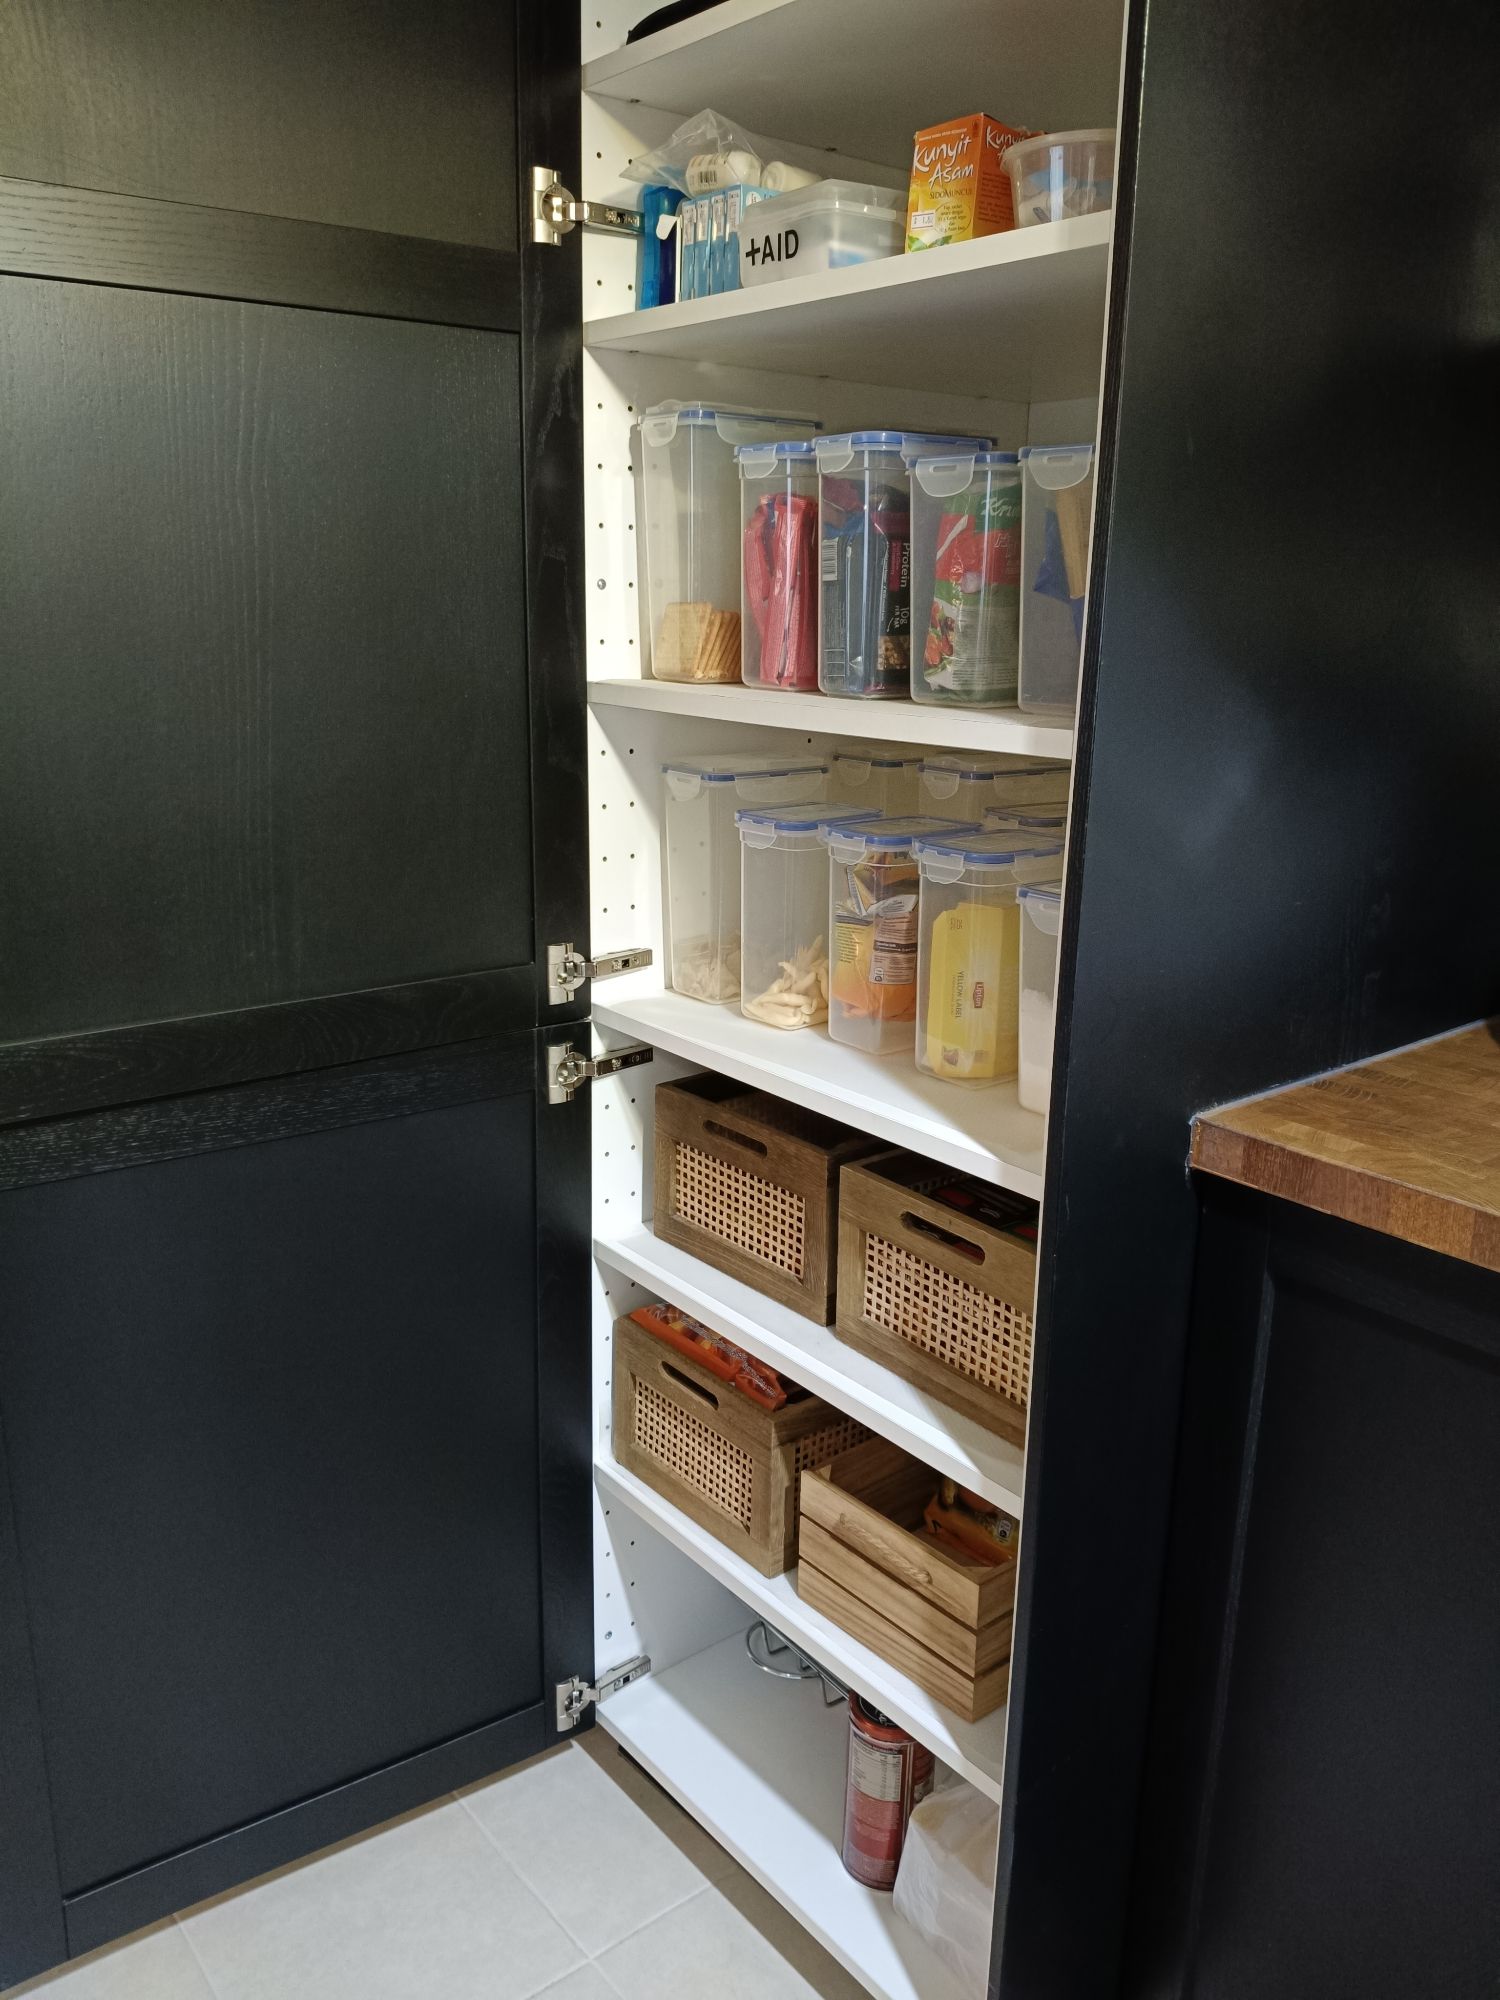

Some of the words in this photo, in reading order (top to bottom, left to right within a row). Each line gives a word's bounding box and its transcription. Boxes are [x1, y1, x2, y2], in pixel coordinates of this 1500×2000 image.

[913, 133, 972, 176] Kunyit
[928, 162, 974, 190] Asam
[900, 542, 911, 588] Protein
[956, 970, 965, 997] YELLOW
